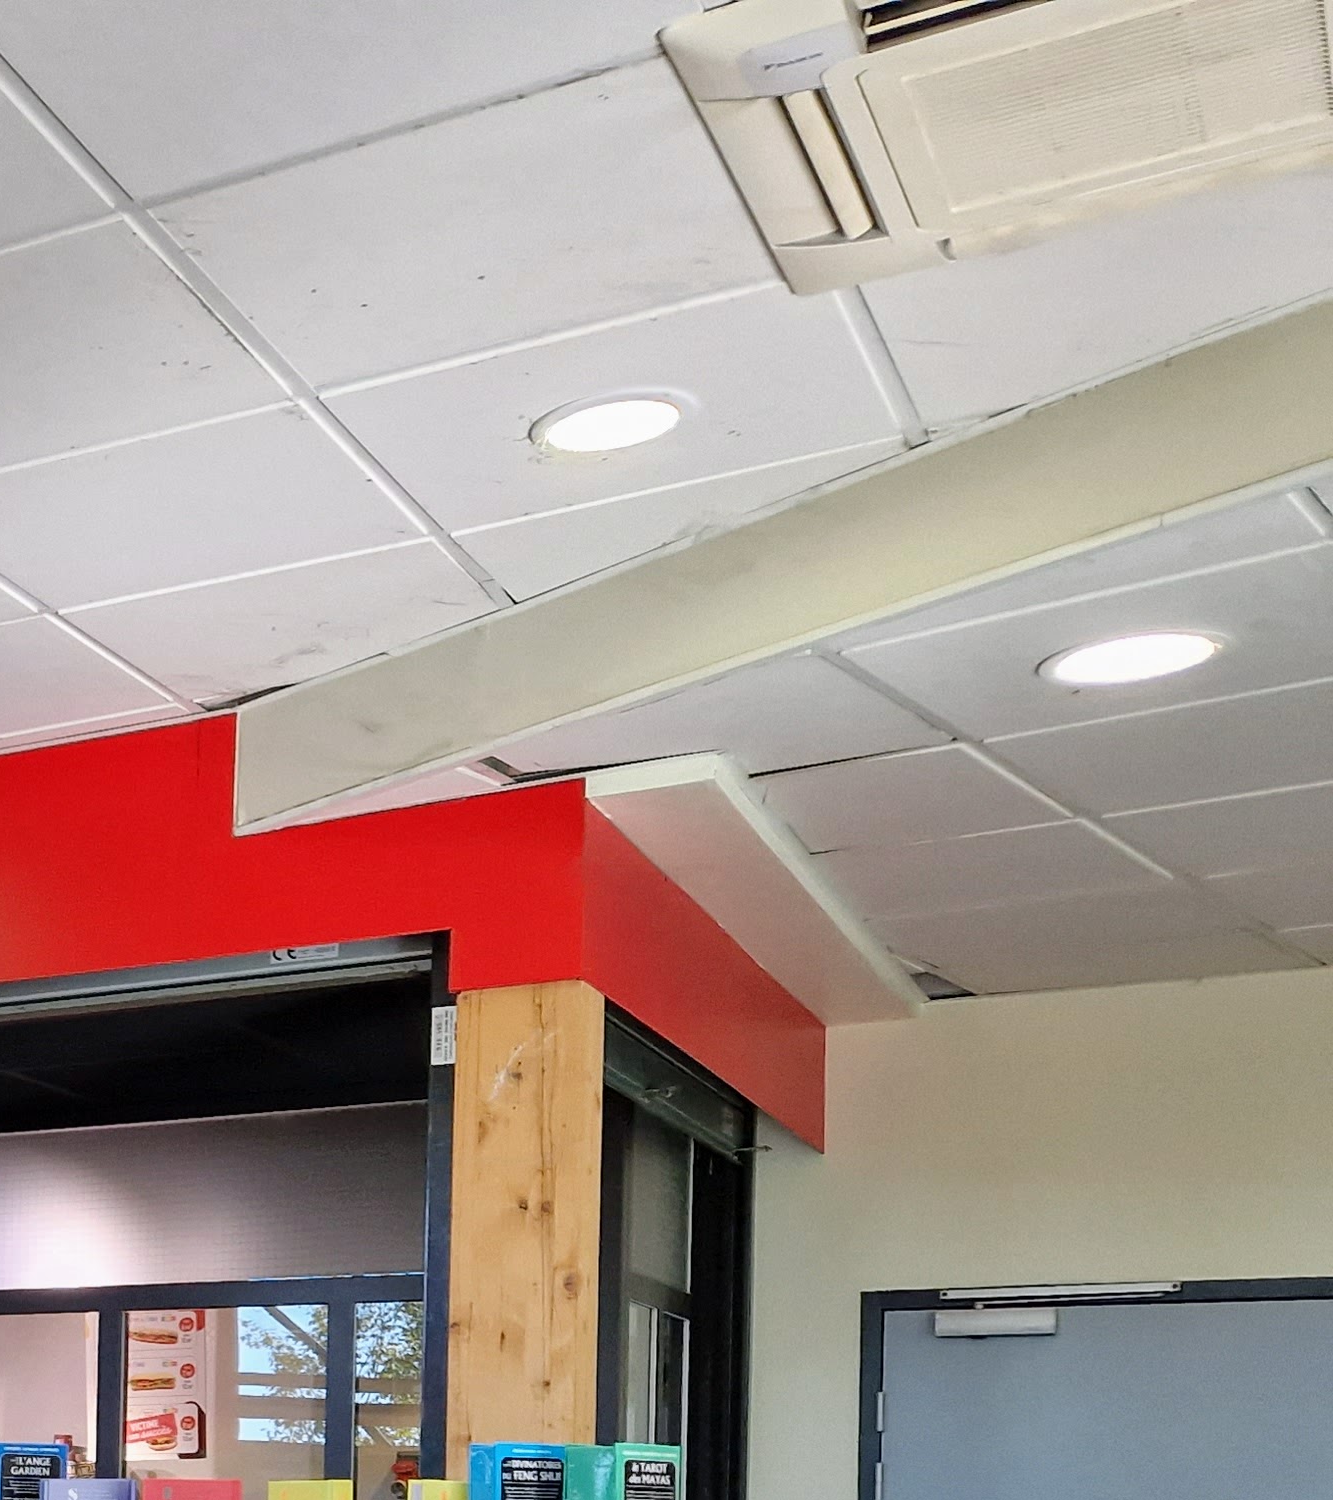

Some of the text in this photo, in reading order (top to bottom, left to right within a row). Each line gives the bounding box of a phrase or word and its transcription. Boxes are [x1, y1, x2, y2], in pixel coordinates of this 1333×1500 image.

[17, 1456, 51, 1467] L'ANGE
[11, 1466, 50, 1476] GARDIEN
[513, 1471, 537, 1482] FENG
[643, 1474, 671, 1486] MAYAS
